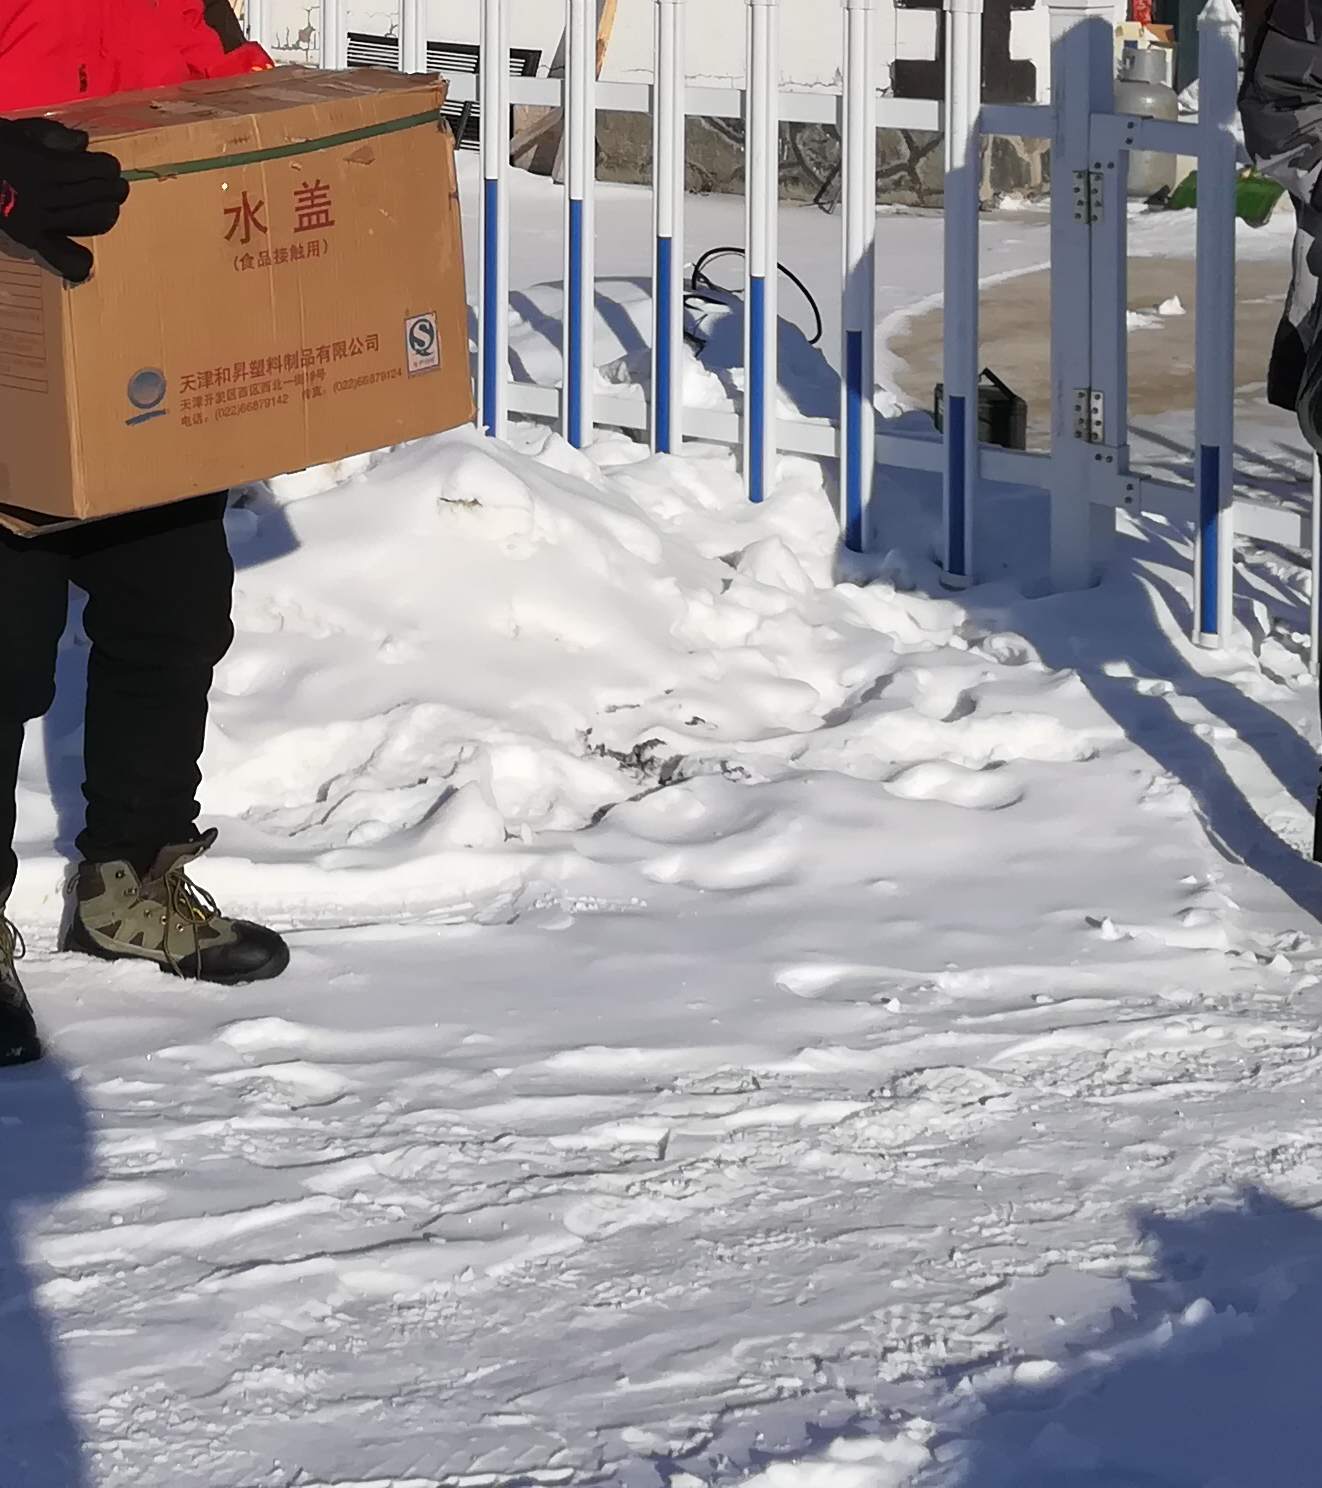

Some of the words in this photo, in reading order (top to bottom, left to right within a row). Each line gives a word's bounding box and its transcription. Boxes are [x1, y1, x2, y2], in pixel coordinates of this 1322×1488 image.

[223, 178, 335, 245] 水盖
[179, 333, 379, 394] 天津和昇塑料制品有限公司
